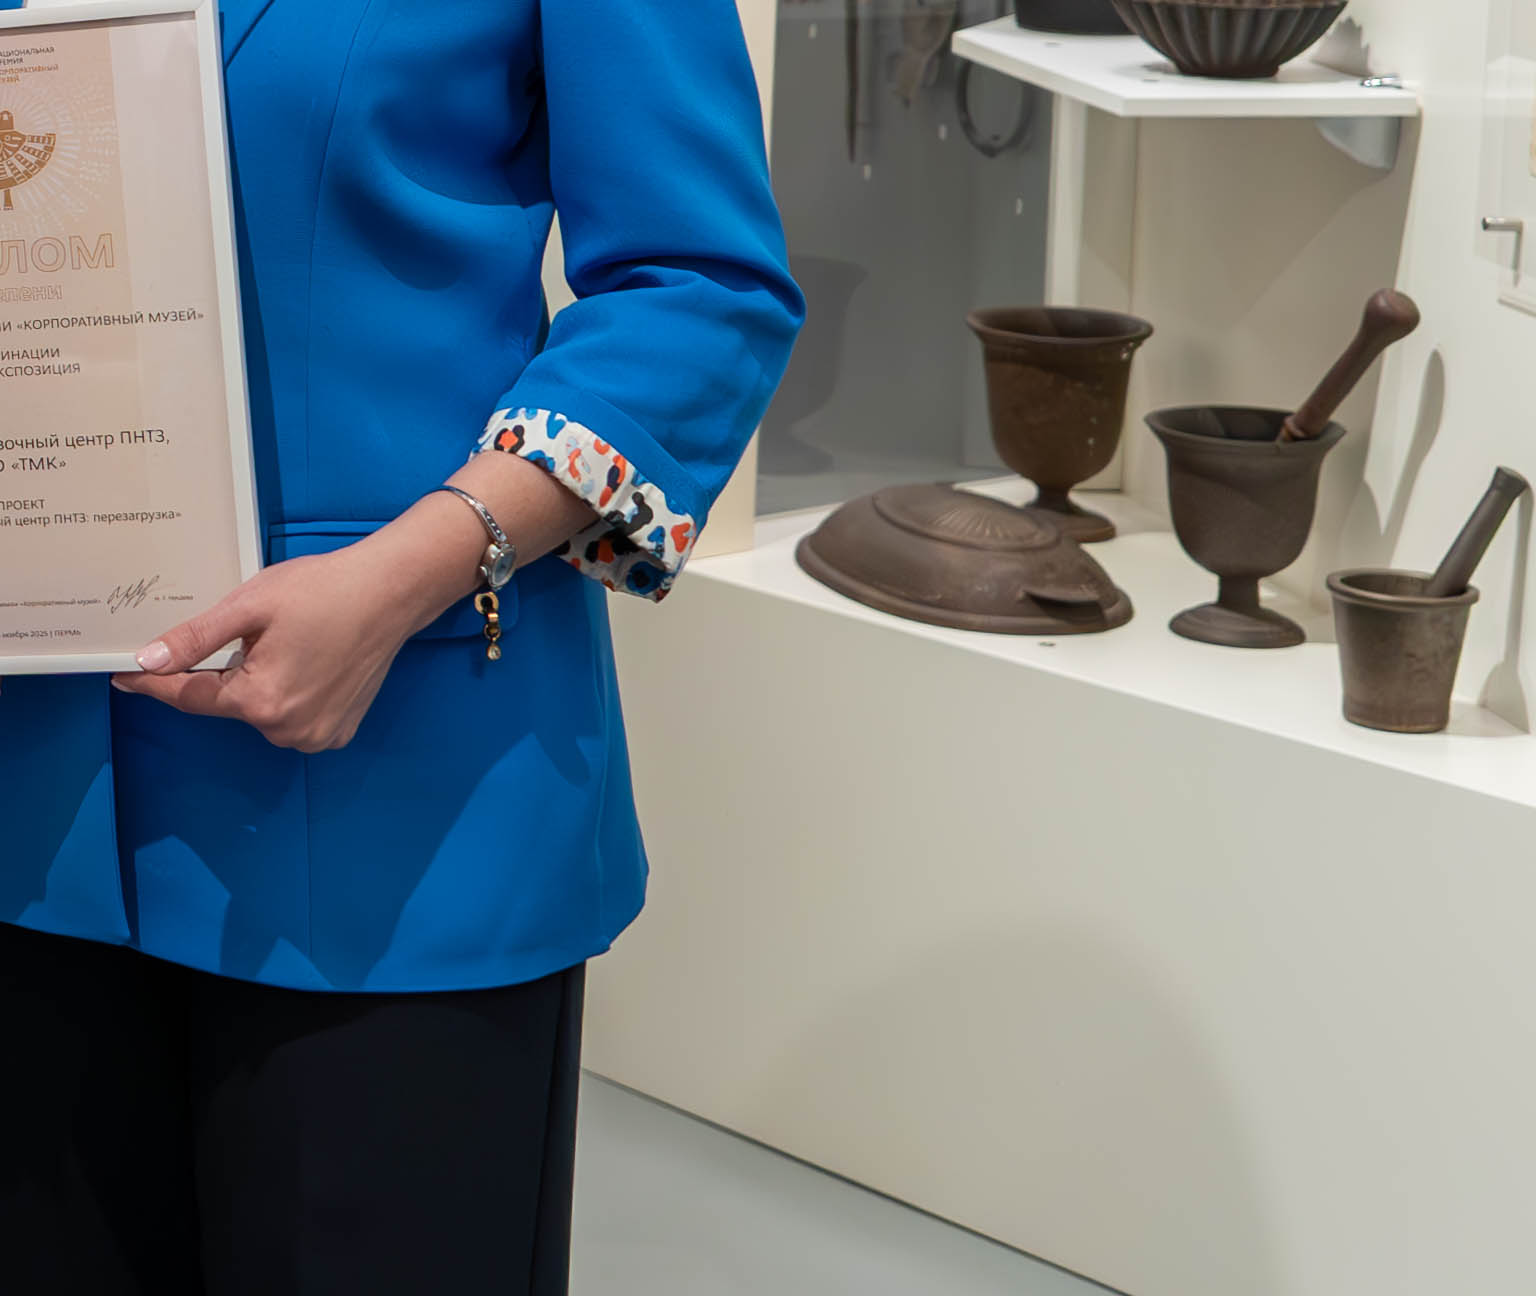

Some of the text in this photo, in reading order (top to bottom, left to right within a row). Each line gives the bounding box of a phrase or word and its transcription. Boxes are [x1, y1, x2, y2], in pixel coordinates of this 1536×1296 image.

[65, 434, 114, 449] центр
[120, 430, 169, 445] ПНТЗ,
[15, 515, 50, 527] центр
[54, 513, 89, 524] ПНТЗ:
